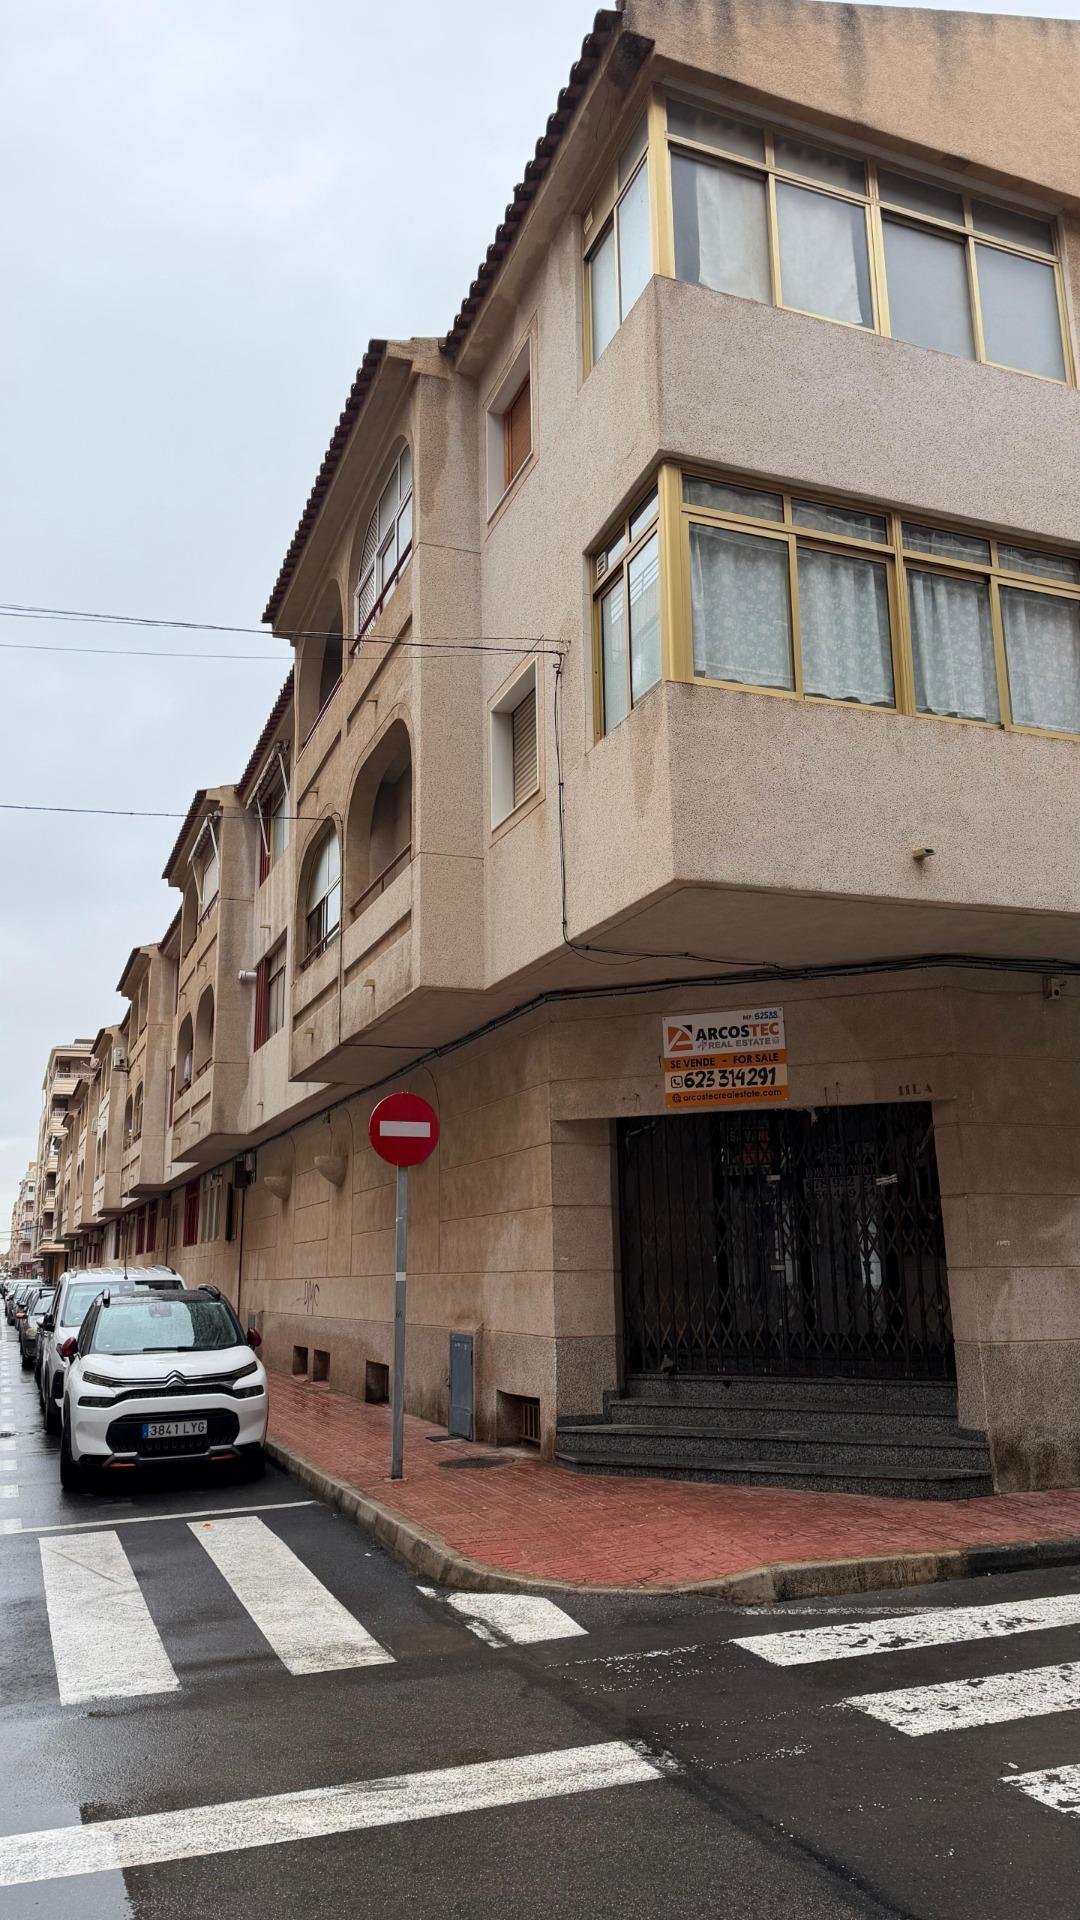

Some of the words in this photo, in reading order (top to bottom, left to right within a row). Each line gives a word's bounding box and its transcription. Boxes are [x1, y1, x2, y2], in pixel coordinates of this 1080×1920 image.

[695, 1022, 780, 1041] ARCOSTEC
[708, 1040, 734, 1049] REAL
[735, 1037, 772, 1047] ESTATE
[670, 1060, 681, 1069] SE
[684, 1058, 716, 1068] VENDE
[733, 1055, 753, 1065] FOR
[755, 1053, 779, 1063] SALE
[684, 1070, 716, 1088] 623
[683, 1088, 782, 1102] arcostecrealestate.com
[151, 1423, 179, 1436] 3841
[183, 1422, 205, 1434] LYG
